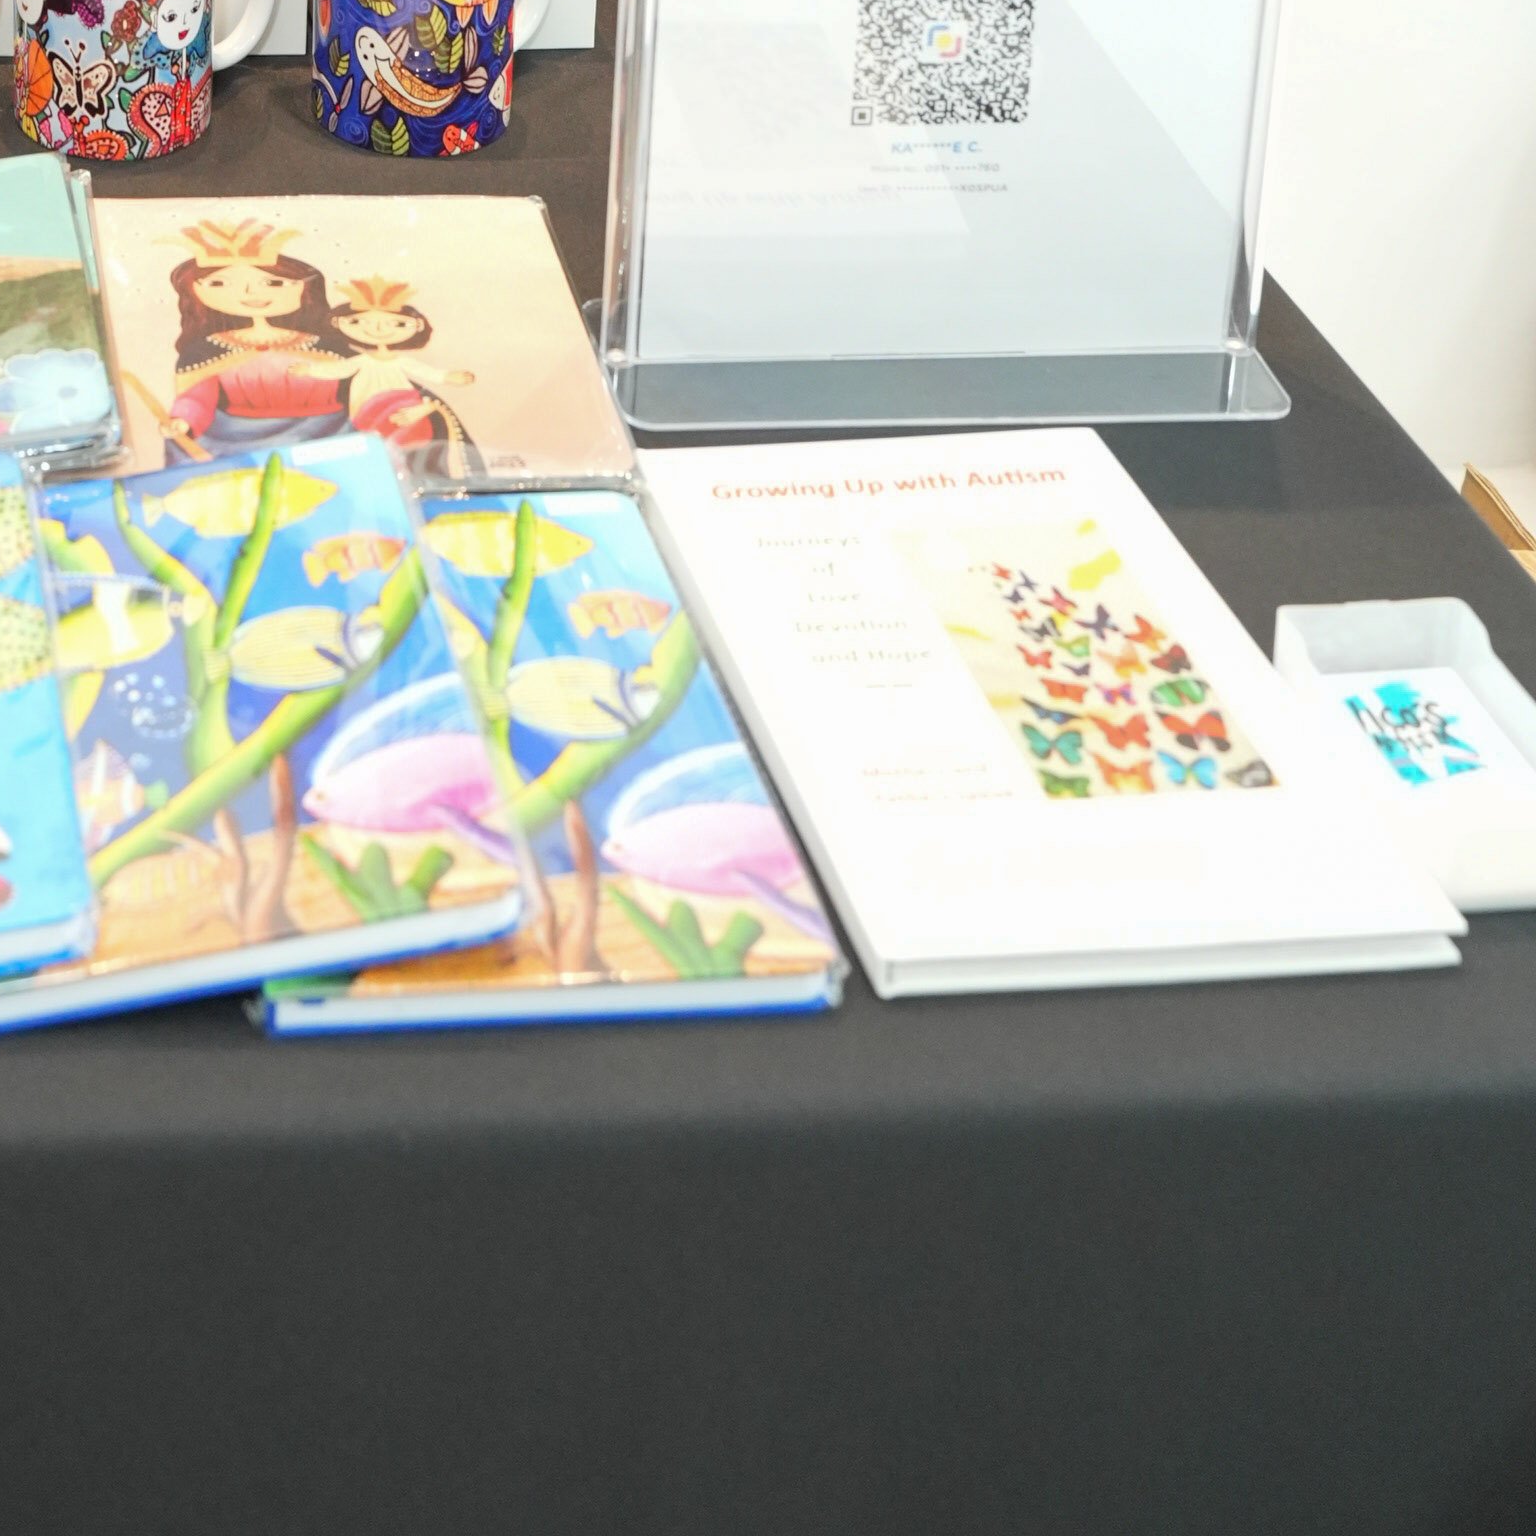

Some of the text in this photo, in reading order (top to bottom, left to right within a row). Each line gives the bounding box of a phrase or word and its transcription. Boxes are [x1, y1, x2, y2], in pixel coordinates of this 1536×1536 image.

[711, 467, 1068, 500] Growing Up with Autism
